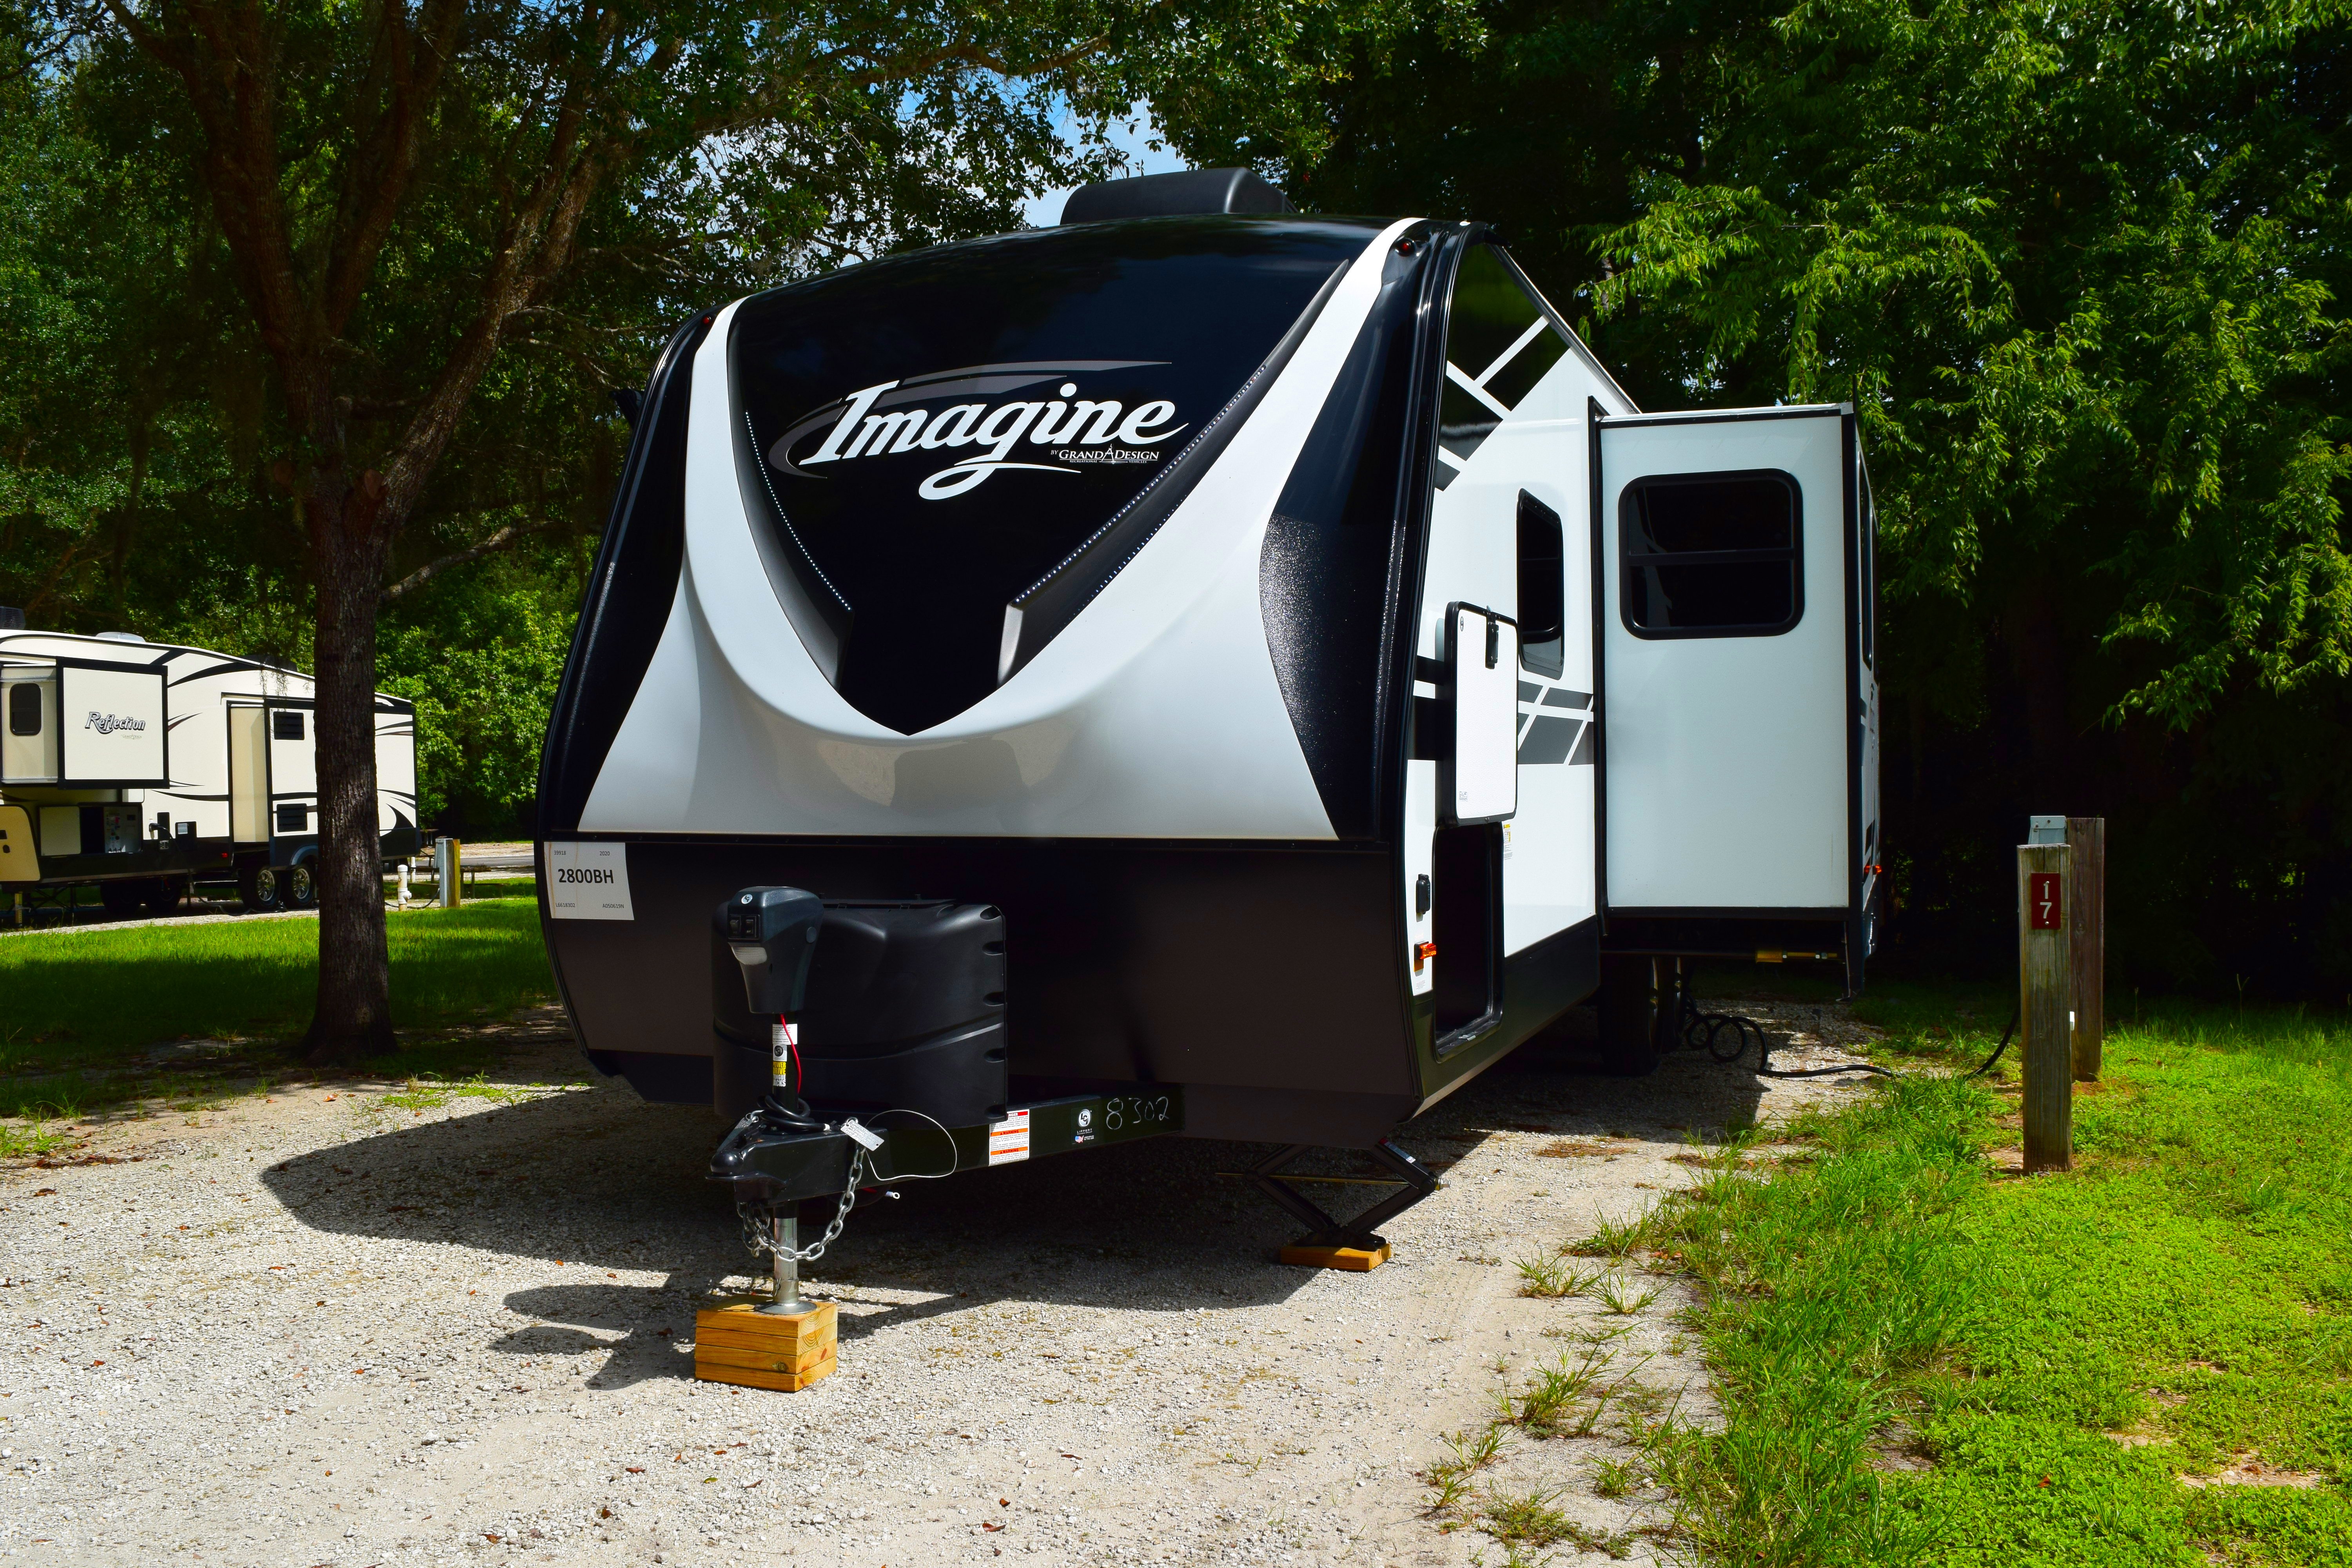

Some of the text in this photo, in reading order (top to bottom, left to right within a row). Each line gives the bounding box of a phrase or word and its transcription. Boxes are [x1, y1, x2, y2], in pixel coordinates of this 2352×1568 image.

[799, 380, 1189, 500] Imagine
[1059, 450, 1103, 459] GRAND
[1114, 450, 1160, 459] DESIGN
[85, 711, 146, 735] Reflection
[558, 868, 614, 884] 2800BH
[1106, 1096, 1169, 1130] 8302
